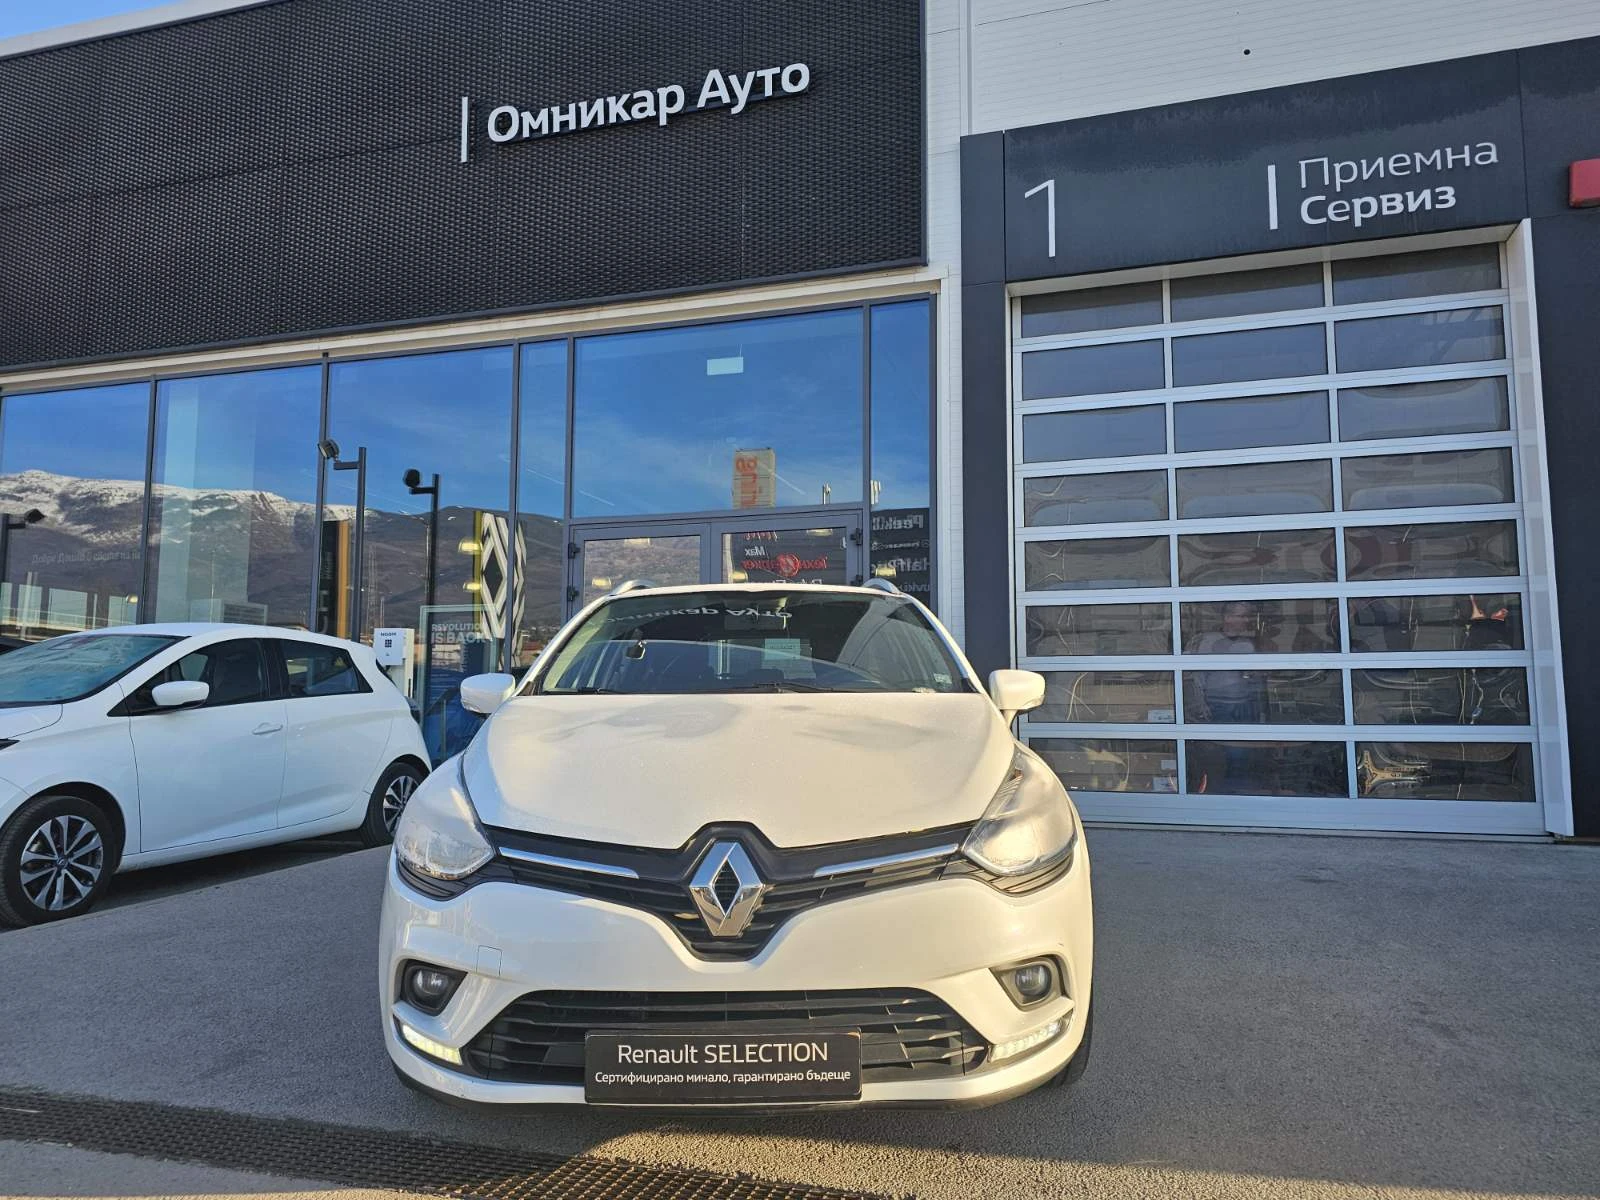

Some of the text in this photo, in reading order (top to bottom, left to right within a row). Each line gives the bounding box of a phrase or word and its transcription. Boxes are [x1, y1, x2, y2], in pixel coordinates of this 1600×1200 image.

[487, 62, 810, 142] Омникар Ауто
[1299, 140, 1499, 191] Приемна
[1024, 178, 1056, 258] 1
[1299, 183, 1457, 228] Сервиз
[617, 1042, 828, 1064] Renault SELECTION
[595, 1070, 851, 1085] Сертифицирано минало, гарантирано бъдеще
